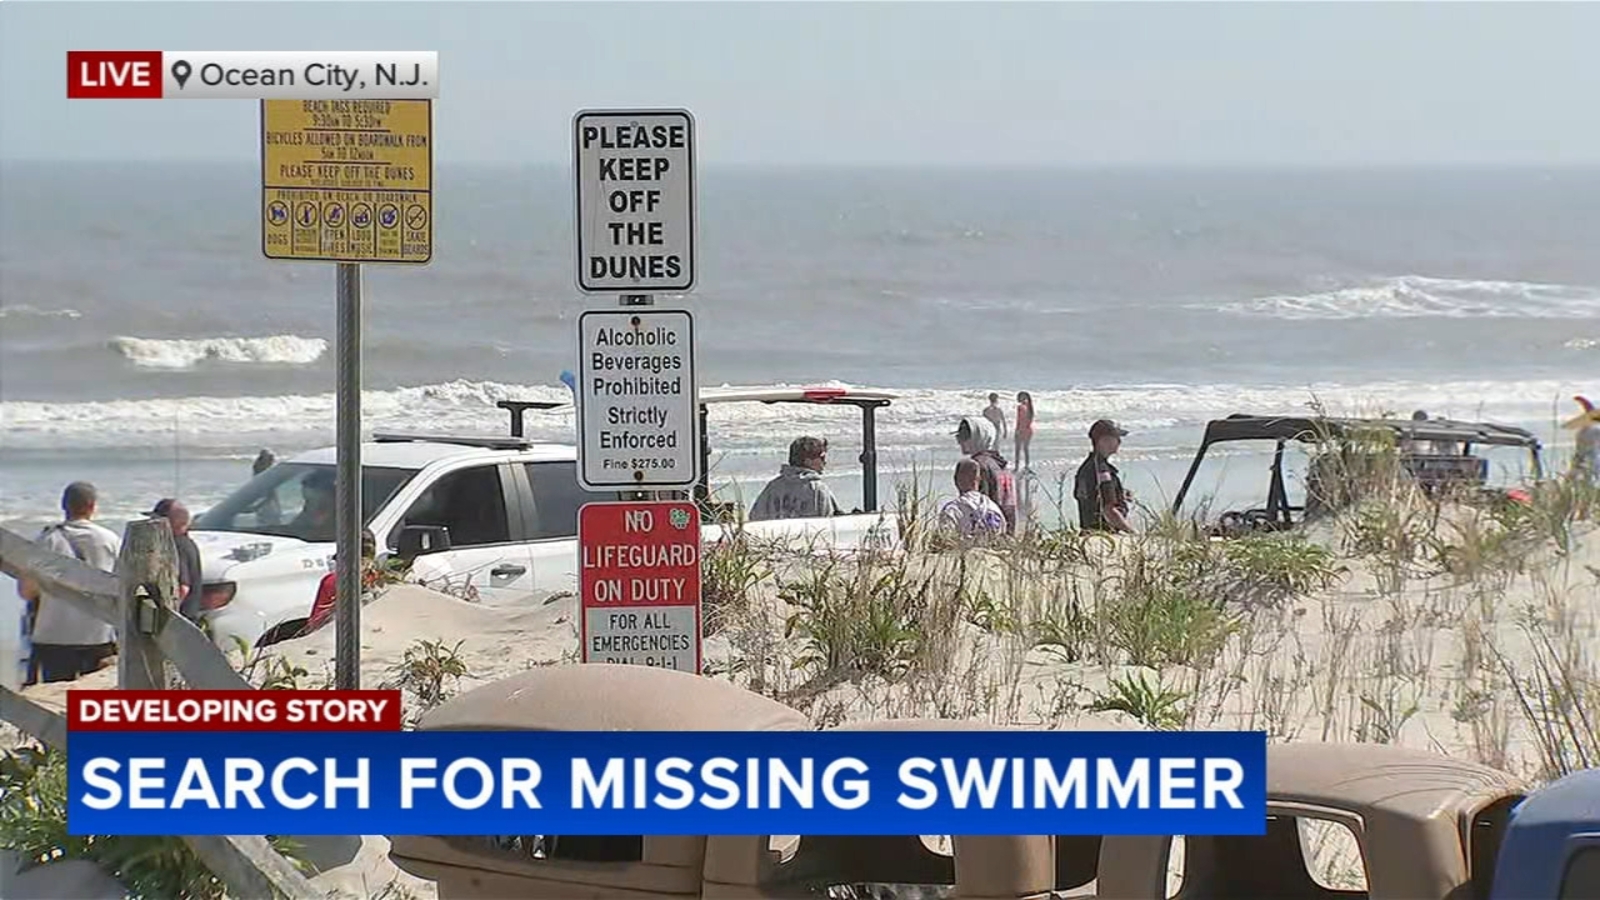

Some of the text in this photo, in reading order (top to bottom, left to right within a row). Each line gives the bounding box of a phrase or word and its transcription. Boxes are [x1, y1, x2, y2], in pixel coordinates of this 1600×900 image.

[266, 132, 428, 148] BICYCLES ALLOWED ON BOARDWALK FROM
[583, 125, 685, 149] PLEASE
[280, 164, 415, 180] PLEASE KEEP OFF THE DUNES
[599, 158, 670, 181] KEEP
[609, 190, 661, 213] OFF
[267, 233, 288, 246] DOGS
[608, 222, 663, 245] THE
[590, 255, 681, 279] DUNES
[596, 327, 676, 346] Alcoholic
[592, 352, 681, 374] Beverages
[593, 377, 681, 396] Prohibited
[608, 406, 667, 428] Strictly
[600, 431, 677, 449] Enforced
[603, 458, 675, 470] Fine $275.00
[625, 510, 653, 533] NO
[584, 544, 696, 568] LIFEGUARD
[594, 578, 686, 601] ON DUTY
[610, 613, 671, 629] FOR ALL
[593, 634, 690, 651] EMERGENCIES
